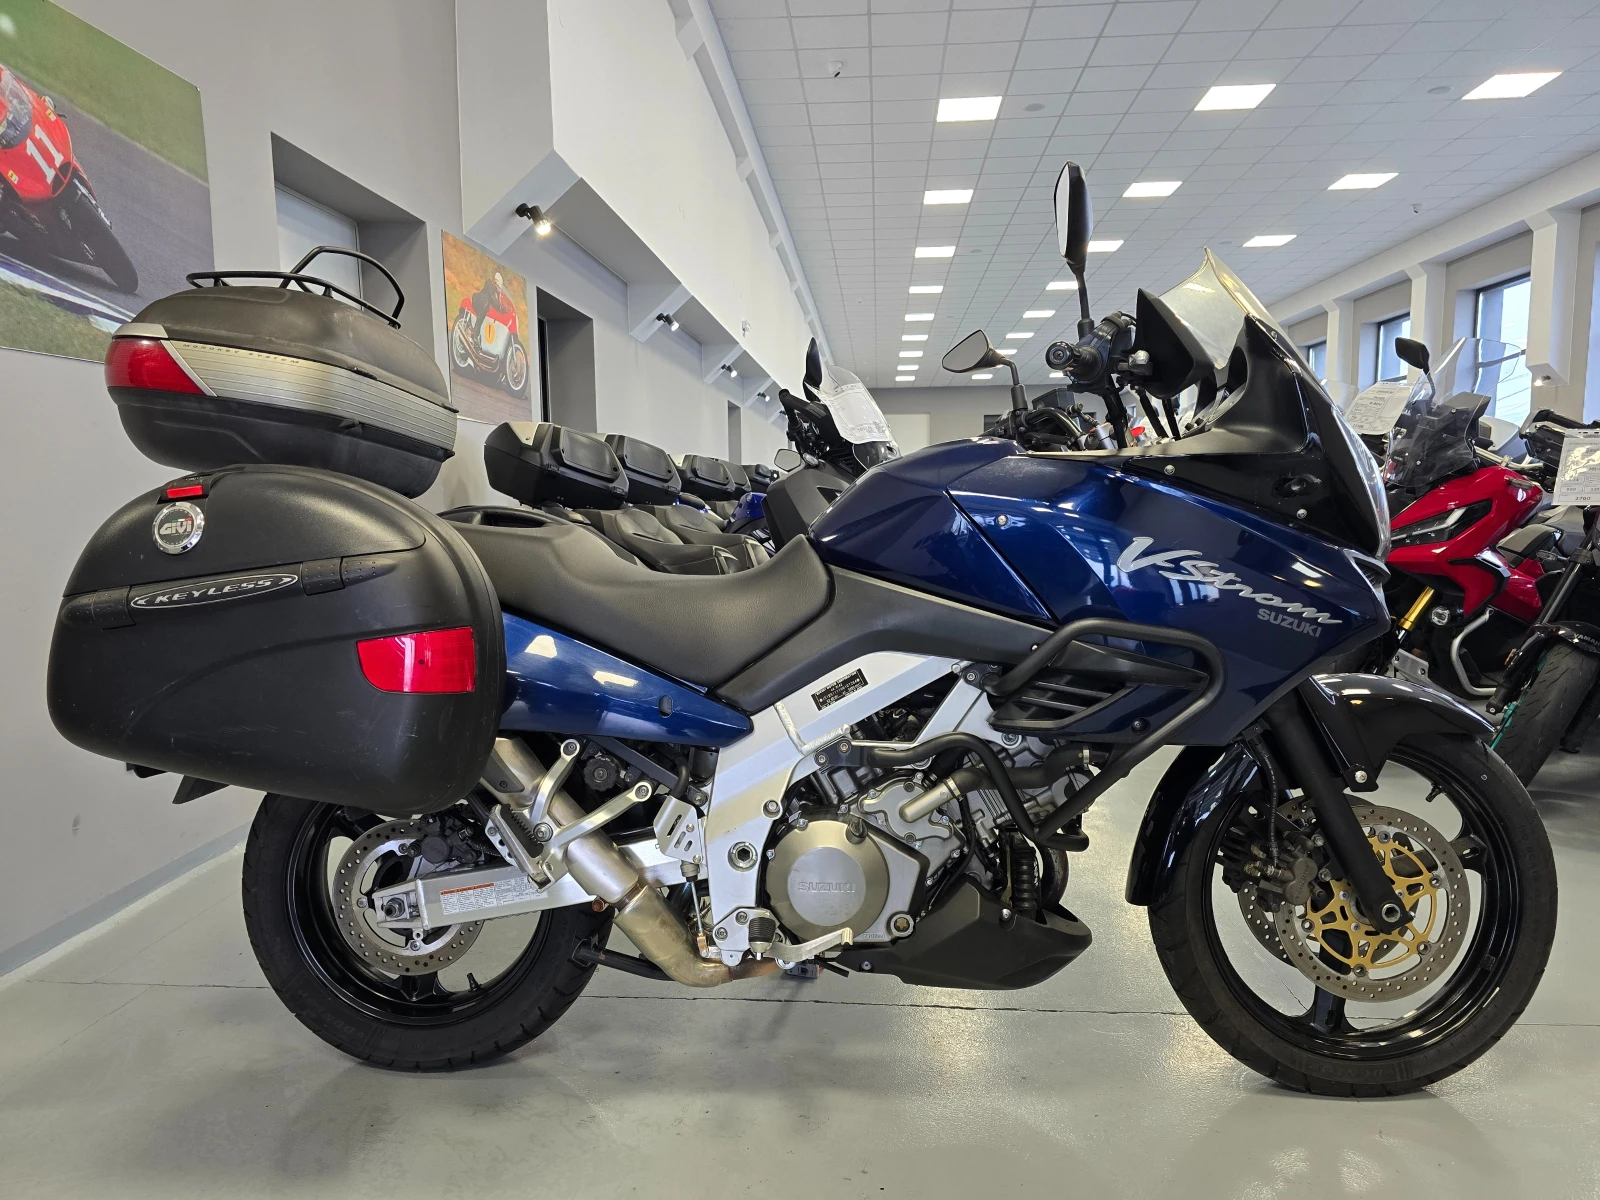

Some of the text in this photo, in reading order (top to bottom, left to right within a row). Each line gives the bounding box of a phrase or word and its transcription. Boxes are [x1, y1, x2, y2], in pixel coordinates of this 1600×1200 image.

[26, 123, 65, 186] 11
[183, 344, 300, 364] MONOKEY SYSTEM
[154, 578, 274, 604] KEYLESS
[1256, 608, 1322, 638] SUZUKI
[797, 881, 856, 893] SUZUKI
